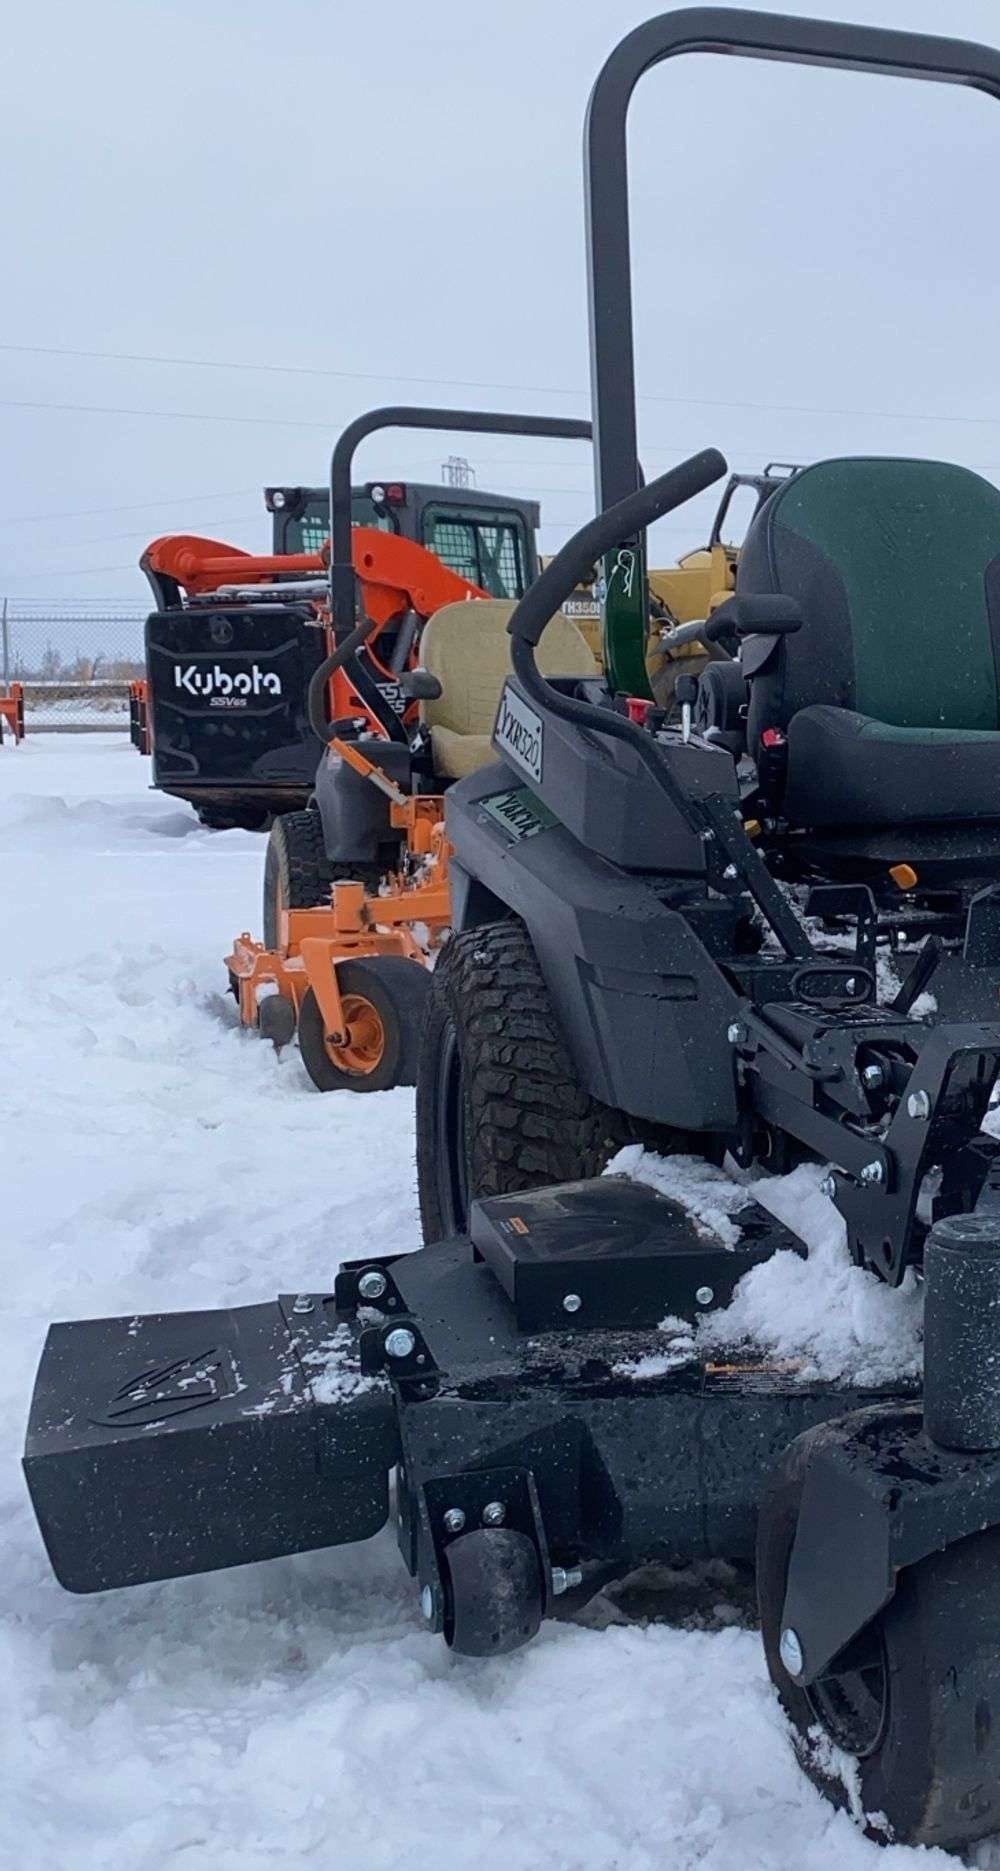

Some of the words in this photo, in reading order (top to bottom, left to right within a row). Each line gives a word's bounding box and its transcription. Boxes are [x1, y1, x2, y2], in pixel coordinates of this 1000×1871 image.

[174, 665, 282, 695] Kubota
[501, 703, 539, 768] YXR320
[496, 792, 541, 837] YAKTA
